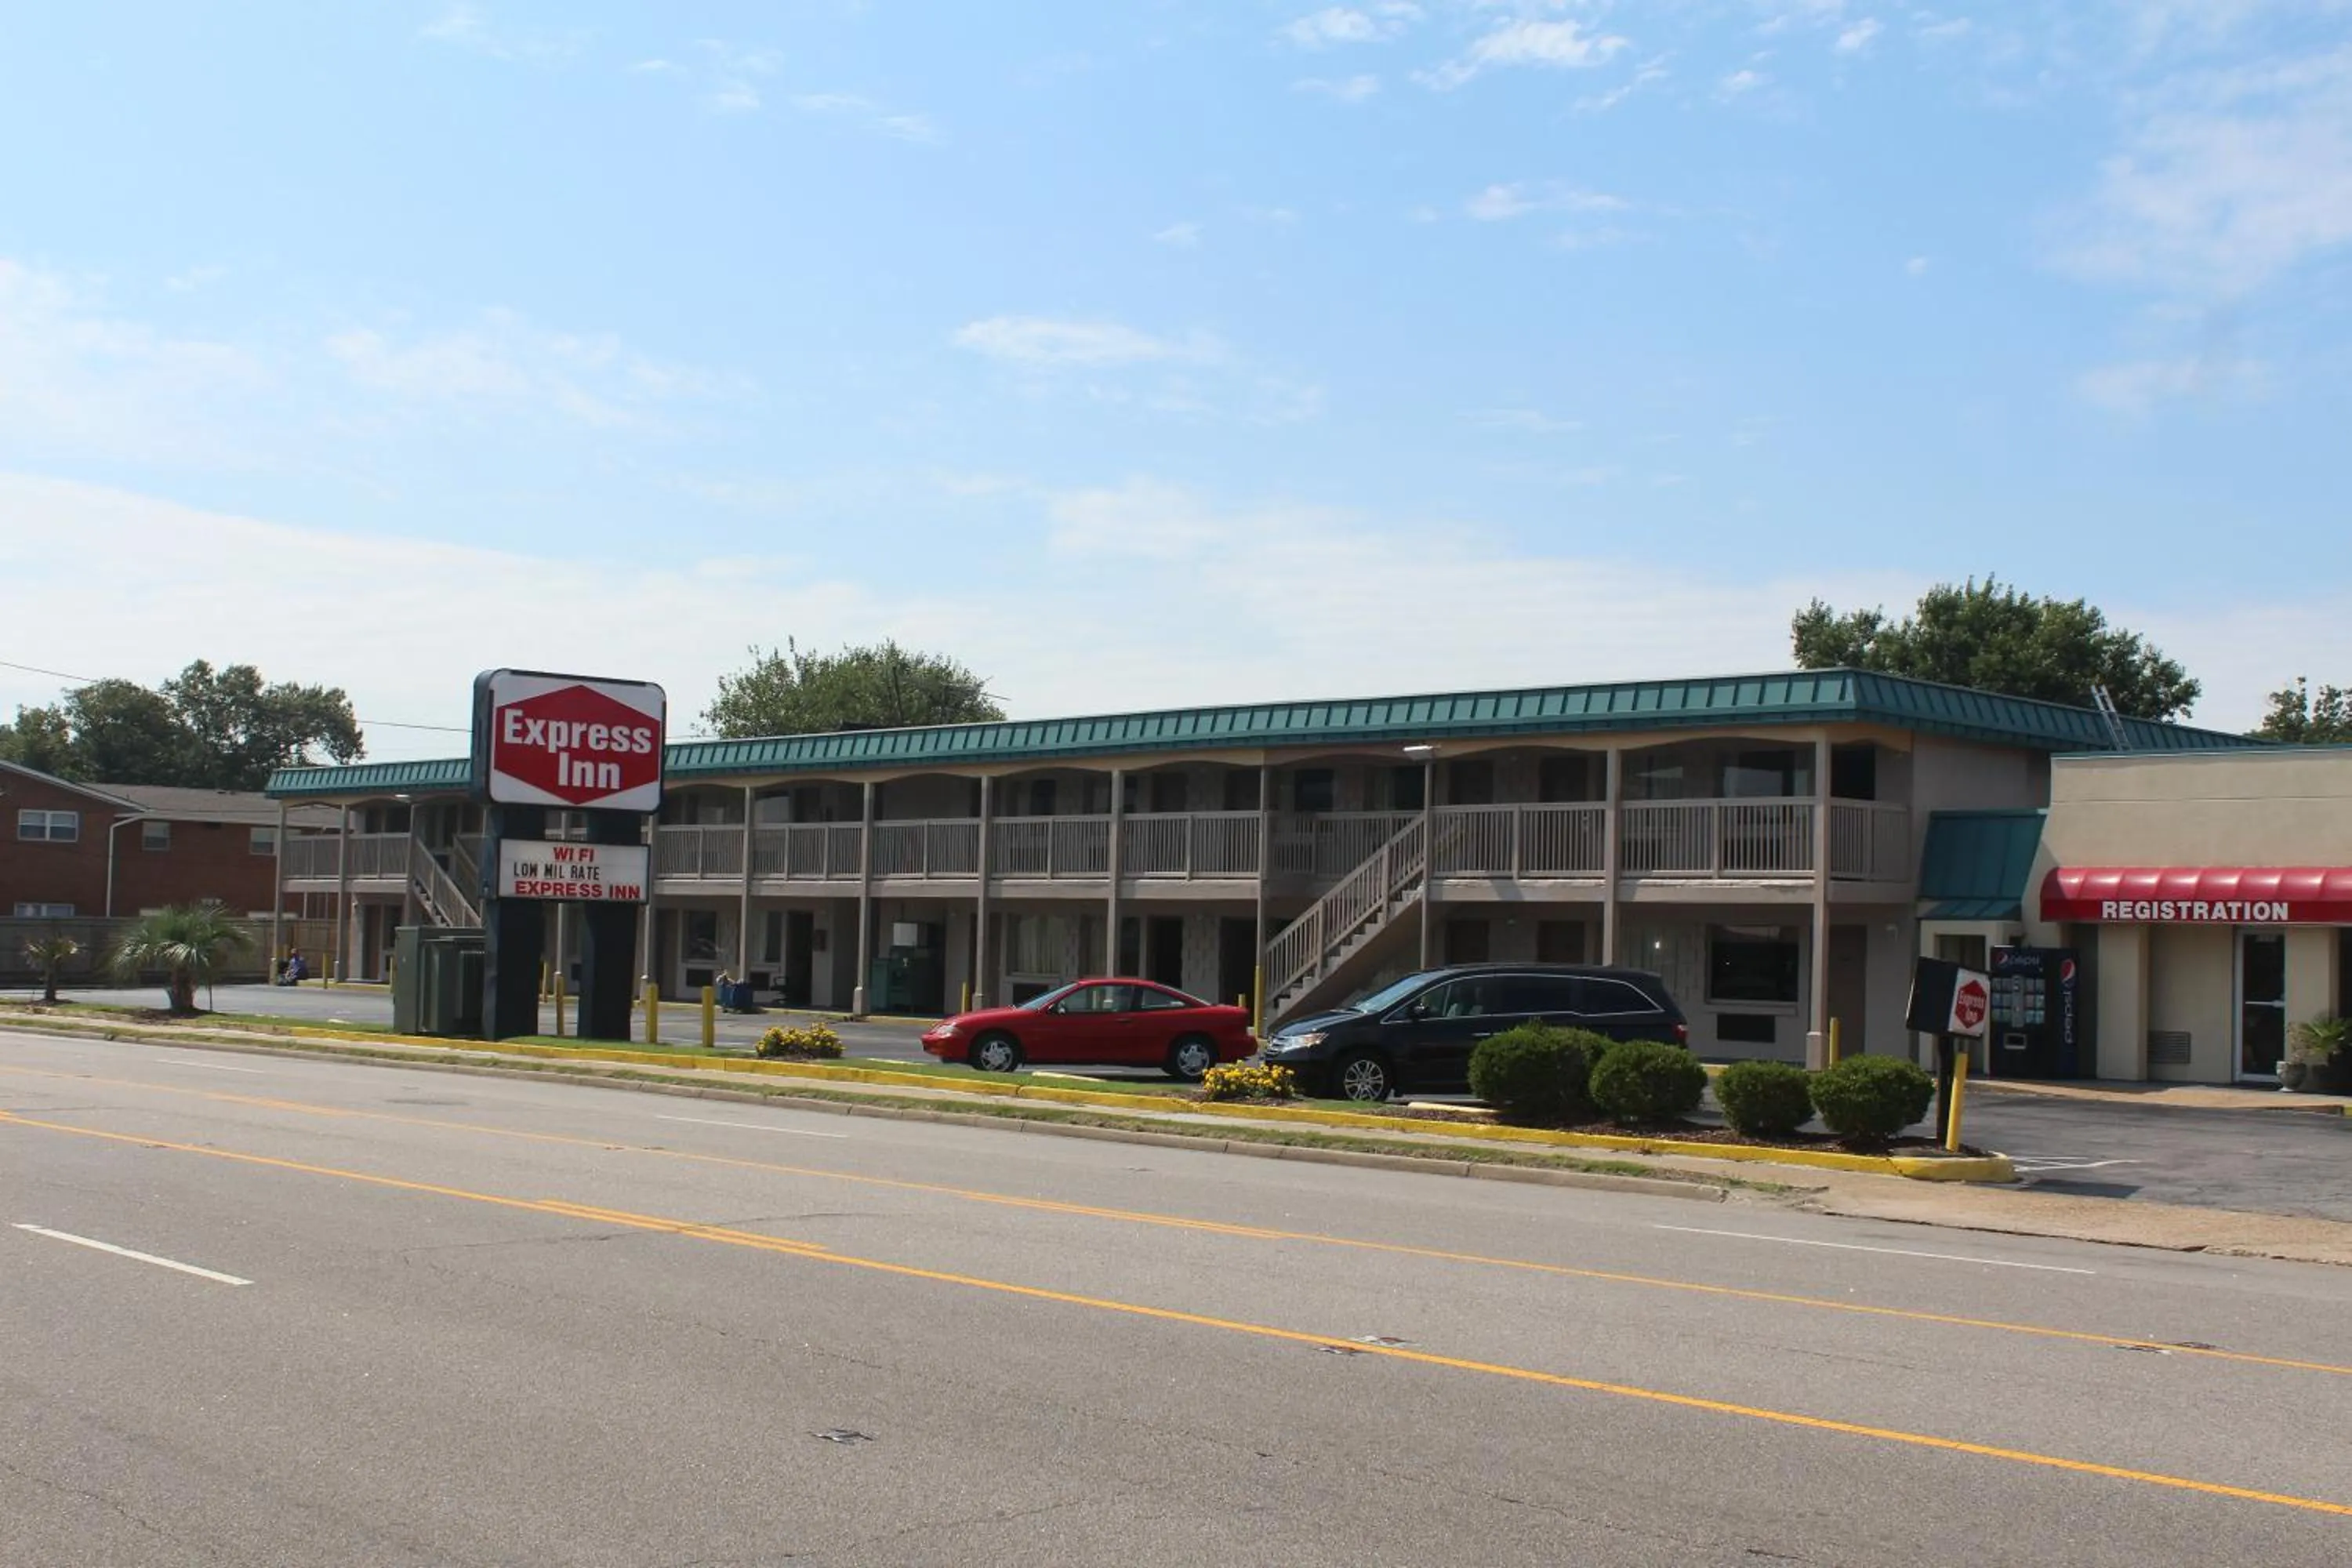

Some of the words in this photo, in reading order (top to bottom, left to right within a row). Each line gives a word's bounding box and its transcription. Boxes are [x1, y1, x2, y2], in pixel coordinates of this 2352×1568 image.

[503, 708, 652, 753] Express
[557, 753, 621, 790] Inn
[554, 847, 573, 862] WI
[579, 848, 594, 862] FI
[570, 866, 600, 880] RATE
[514, 880, 603, 898] EXPRESS
[609, 884, 641, 899] INN
[2102, 901, 2288, 921] REGISTRATION
